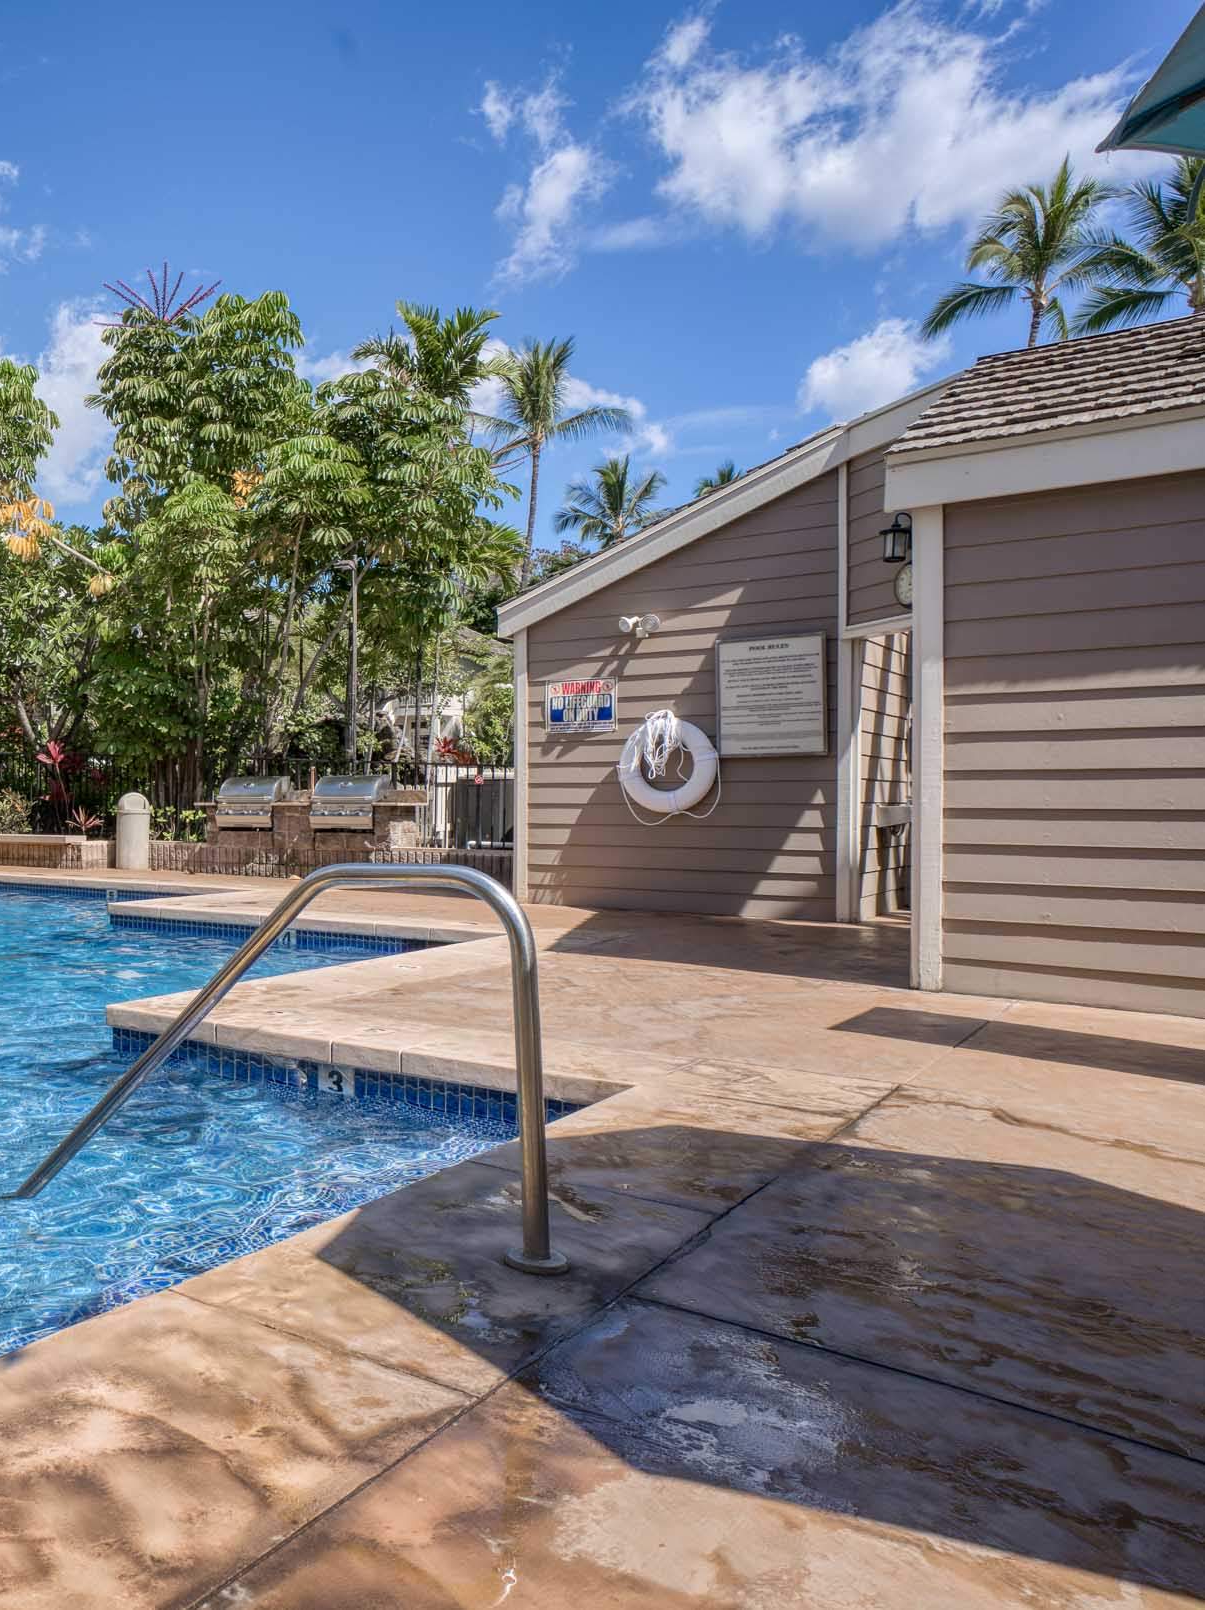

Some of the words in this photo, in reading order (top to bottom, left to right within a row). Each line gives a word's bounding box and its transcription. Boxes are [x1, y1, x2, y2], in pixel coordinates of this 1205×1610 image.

[561, 680, 601, 695] WARNING
[552, 697, 564, 710] NO
[565, 694, 610, 708] LIFEGUARD
[562, 708, 575, 722] ON
[576, 706, 599, 721] DUTY
[328, 1070, 343, 1092] 3
